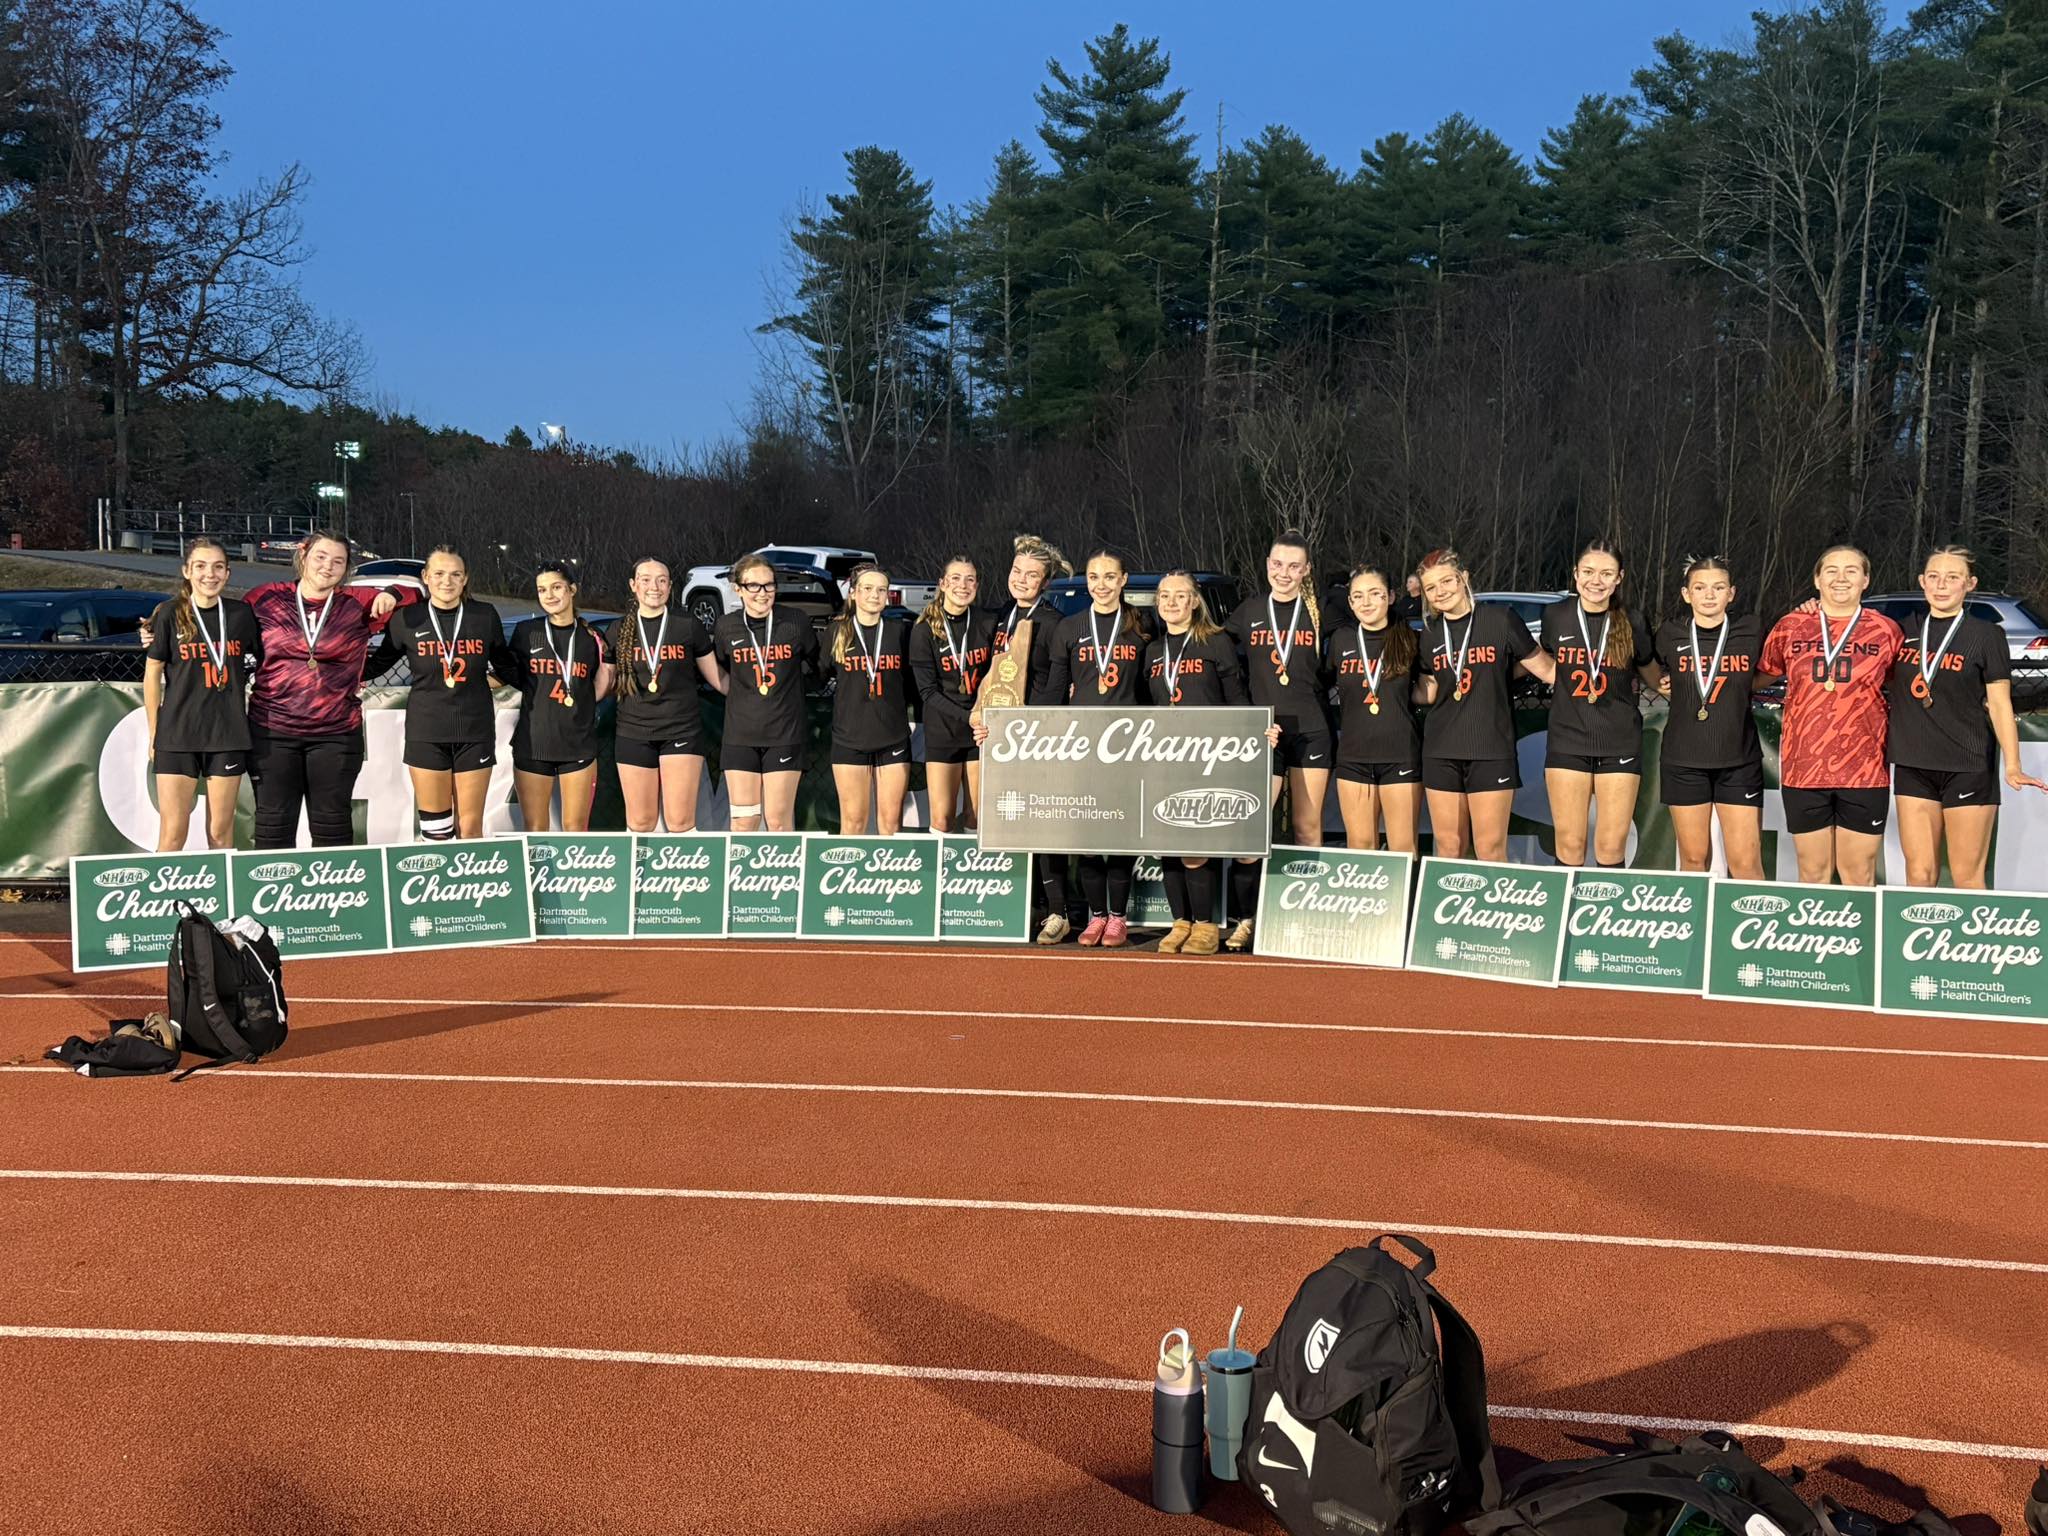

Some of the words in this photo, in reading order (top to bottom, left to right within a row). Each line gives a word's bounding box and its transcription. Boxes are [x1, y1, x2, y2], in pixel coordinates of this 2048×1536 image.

[1250, 629, 1314, 646] STEVNS
[1791, 640, 1880, 657] STEENS
[178, 640, 241, 661] STENS
[941, 647, 988, 672] STVEN
[1078, 644, 1137, 662] STENS
[1432, 646, 1496, 672] STENS
[1557, 646, 1617, 667] STEV
[1897, 647, 1965, 671] STENS
[201, 661, 229, 689] 10
[440, 657, 467, 682] 12
[530, 658, 588, 679] STENS
[752, 663, 777, 688] 15
[1150, 658, 1203, 678] STENS
[1340, 658, 1378, 674] STEV
[1812, 655, 1853, 683] 00
[549, 679, 566, 704] 4
[1571, 669, 1608, 697] 20
[1910, 671, 1929, 699] 6
[991, 718, 1090, 764] State
[1096, 717, 1262, 776] Champs
[1029, 793, 1097, 807] Dartmouth
[1161, 792, 1251, 825] NHIAA
[1029, 807, 1067, 820] Health
[1068, 807, 1125, 821] Children's
[446, 851, 510, 878] State
[556, 845, 616, 871] State
[651, 846, 711, 871] State
[864, 848, 922, 872] State
[955, 848, 1014, 872] State
[148, 864, 217, 893] State
[301, 860, 367, 887] State
[529, 865, 617, 902] hamps
[635, 866, 711, 902] hamps
[729, 864, 800, 901] hamp
[819, 867, 923, 904] Champs
[941, 867, 1014, 904] amps
[1327, 862, 1390, 891] State
[251, 883, 370, 918] Champs
[400, 874, 513, 908] Champs
[1279, 880, 1388, 924] Champs
[1484, 877, 1548, 907] State
[1622, 884, 1693, 913] State
[434, 914, 486, 925] Dartmouth
[539, 907, 588, 916] Dartmouth
[539, 916, 567, 925] Health
[567, 916, 608, 925] Children's
[635, 907, 682, 916] Dartmouth
[661, 915, 702, 925] Children's
[732, 906, 780, 914] Dartmouth
[732, 914, 760, 923] Health
[760, 914, 798, 924] Children'
[847, 908, 894, 918] Dartmouth
[847, 917, 873, 926] Health
[874, 917, 914, 927] Children's
[1434, 895, 1545, 939] Champs
[1787, 898, 1862, 929] State
[1961, 906, 2041, 937] State
[287, 924, 341, 935] Dartmouth
[435, 923, 465, 934] Health
[465, 921, 507, 932] Children's
[965, 918, 1004, 927] Children's
[1568, 904, 1694, 949] Champs
[133, 932, 175, 943] Dartmo
[133, 942, 164, 953] Health
[287, 933, 318, 945] Health
[319, 931, 363, 943] Children's
[1460, 941, 1511, 955] Dartmouth
[1730, 918, 1863, 964] Champs
[1459, 951, 1487, 962] Health
[1488, 954, 1531, 967] Children's
[1601, 952, 1659, 965] Dartmouth
[1902, 927, 2043, 975] Champs
[1601, 963, 1634, 975] Health
[1634, 965, 1683, 977] Children's
[1766, 967, 1826, 981] Dartmouth
[1765, 978, 1800, 990] Health
[1800, 979, 1851, 993] Children's
[1941, 978, 2005, 992] Dartmouth
[1941, 990, 1977, 1002] Health
[1977, 992, 2032, 1005] Children's
